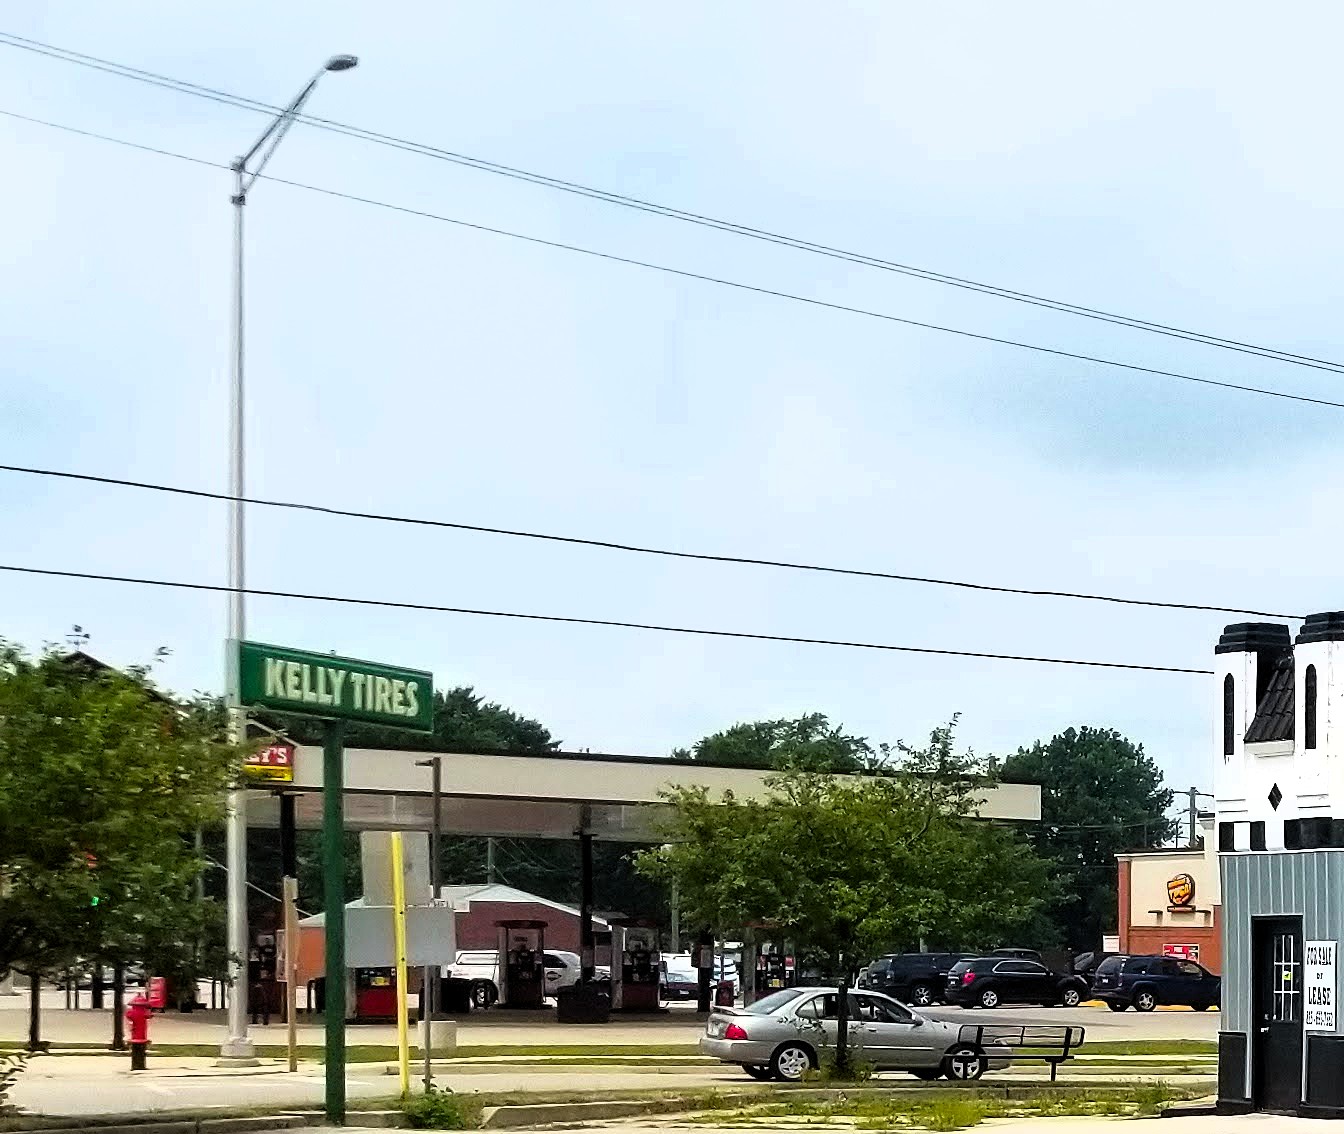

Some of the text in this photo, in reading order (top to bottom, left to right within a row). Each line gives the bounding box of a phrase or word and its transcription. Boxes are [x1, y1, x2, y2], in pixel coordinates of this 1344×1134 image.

[264, 657, 419, 717] KELLY TIRES
[1308, 986, 1332, 1006] LEASE
